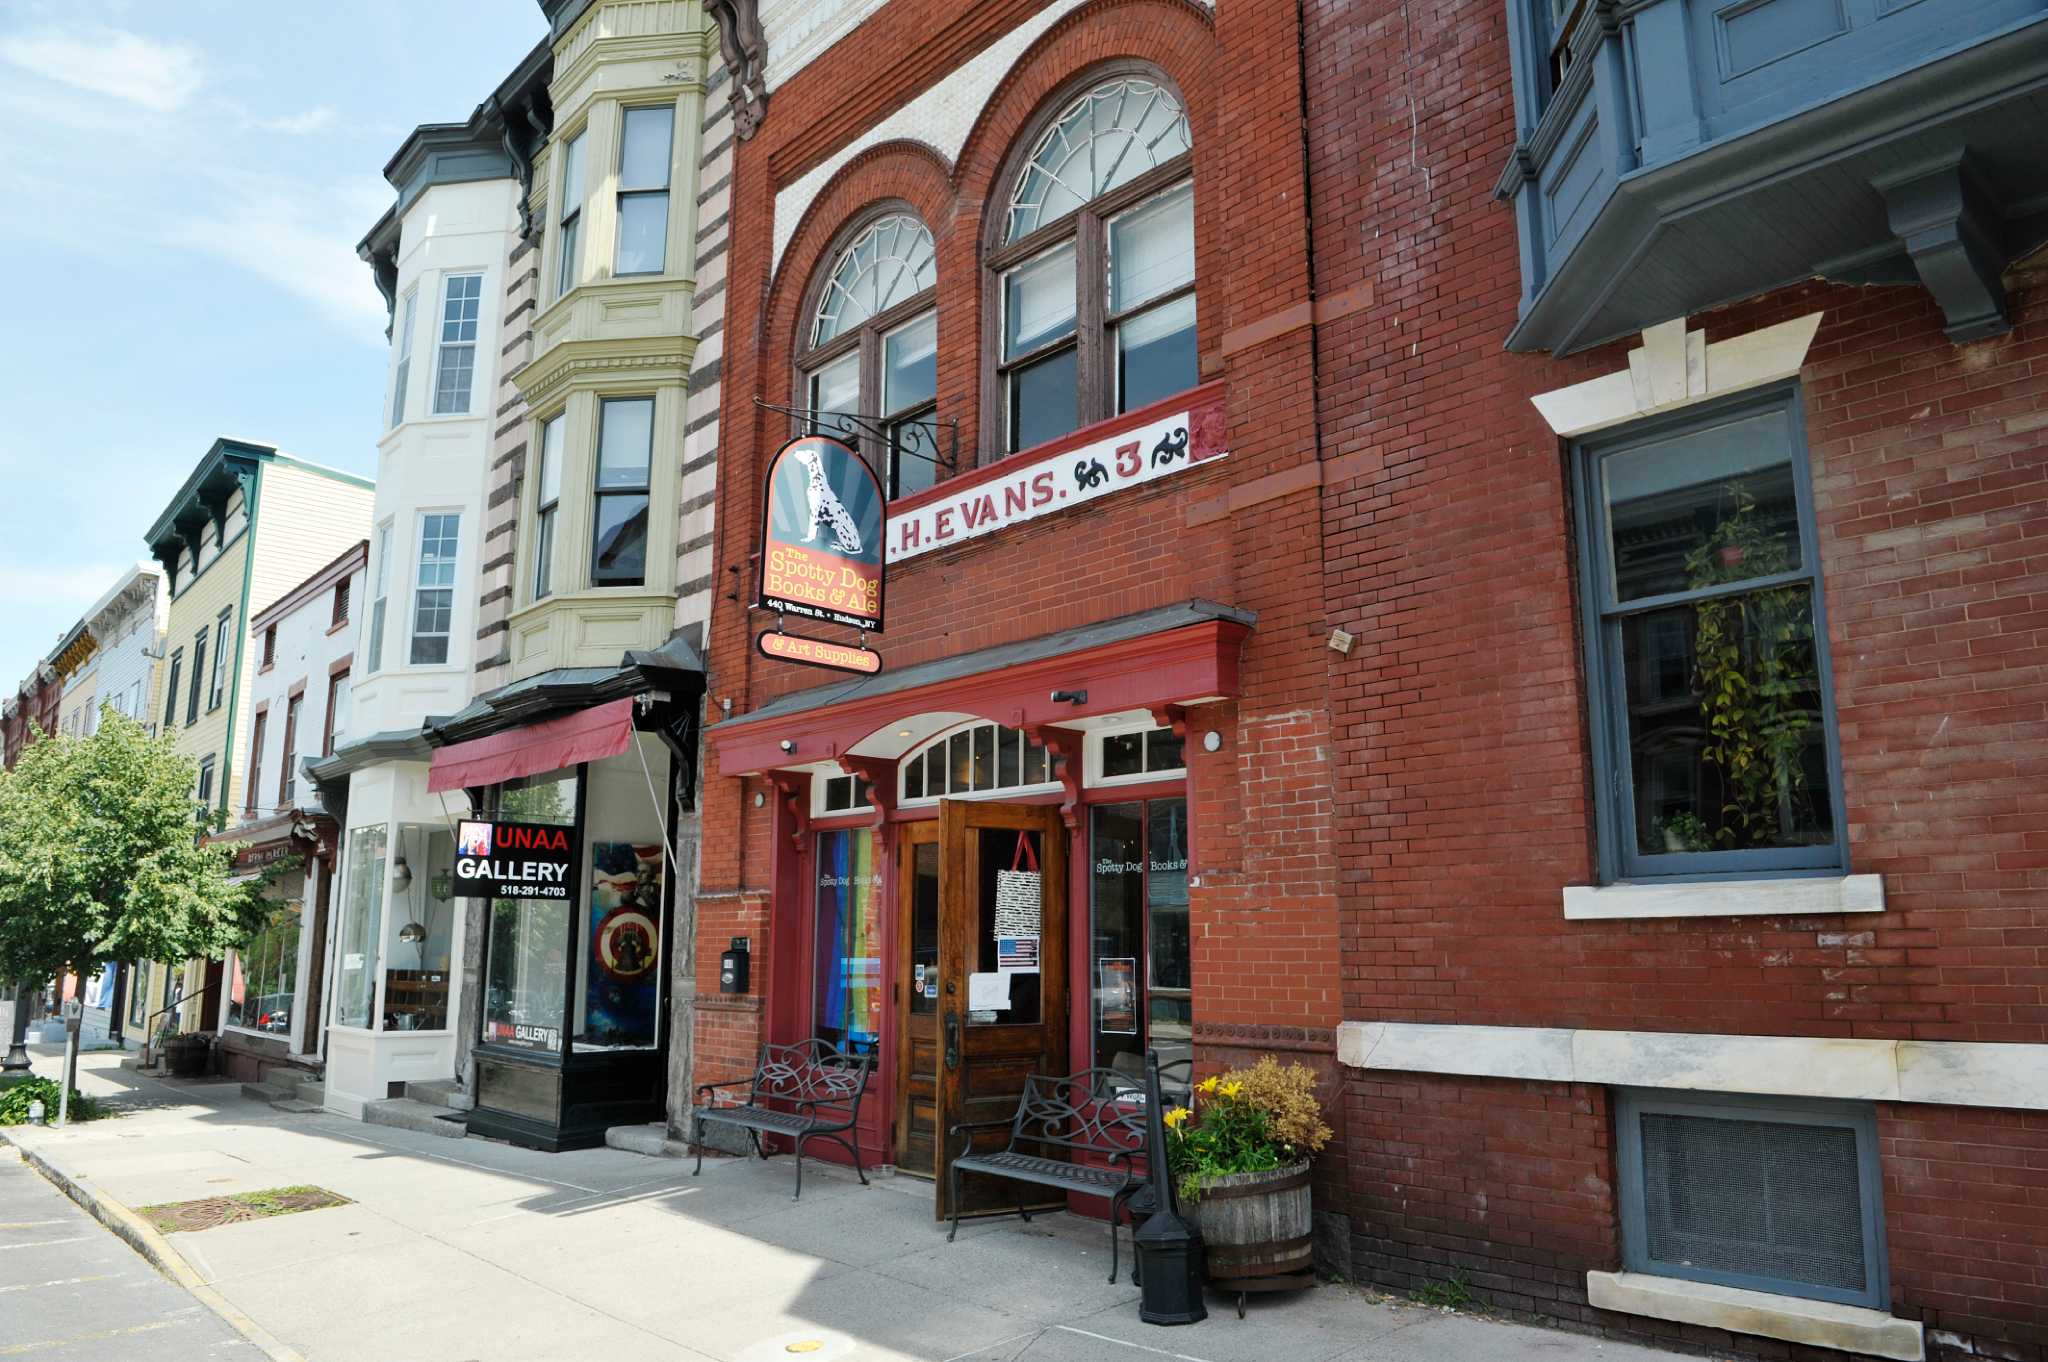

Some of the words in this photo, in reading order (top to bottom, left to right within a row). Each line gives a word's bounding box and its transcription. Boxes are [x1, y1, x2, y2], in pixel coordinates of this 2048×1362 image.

[1115, 440, 1142, 478] 3
[785, 548, 809, 560] The
[770, 550, 836, 586] Spotty
[840, 567, 878, 597] Dog
[768, 574, 825, 601] Books
[829, 588, 845, 605] &
[847, 593, 877, 613] Ale
[767, 599, 783, 609] 440
[784, 603, 813, 616] Warren
[864, 620, 876, 629] NY
[772, 639, 784, 650] &
[787, 641, 811, 656] Art
[815, 646, 870, 667] Supplies
[496, 827, 568, 850] UNAA
[456, 858, 569, 882] GALLERY
[1096, 863, 1124, 875] Spotty
[1126, 861, 1143, 873] Dog
[1151, 860, 1178, 871] Books
[500, 885, 566, 897] 518-291-4703
[515, 1024, 549, 1042] GALLERY
